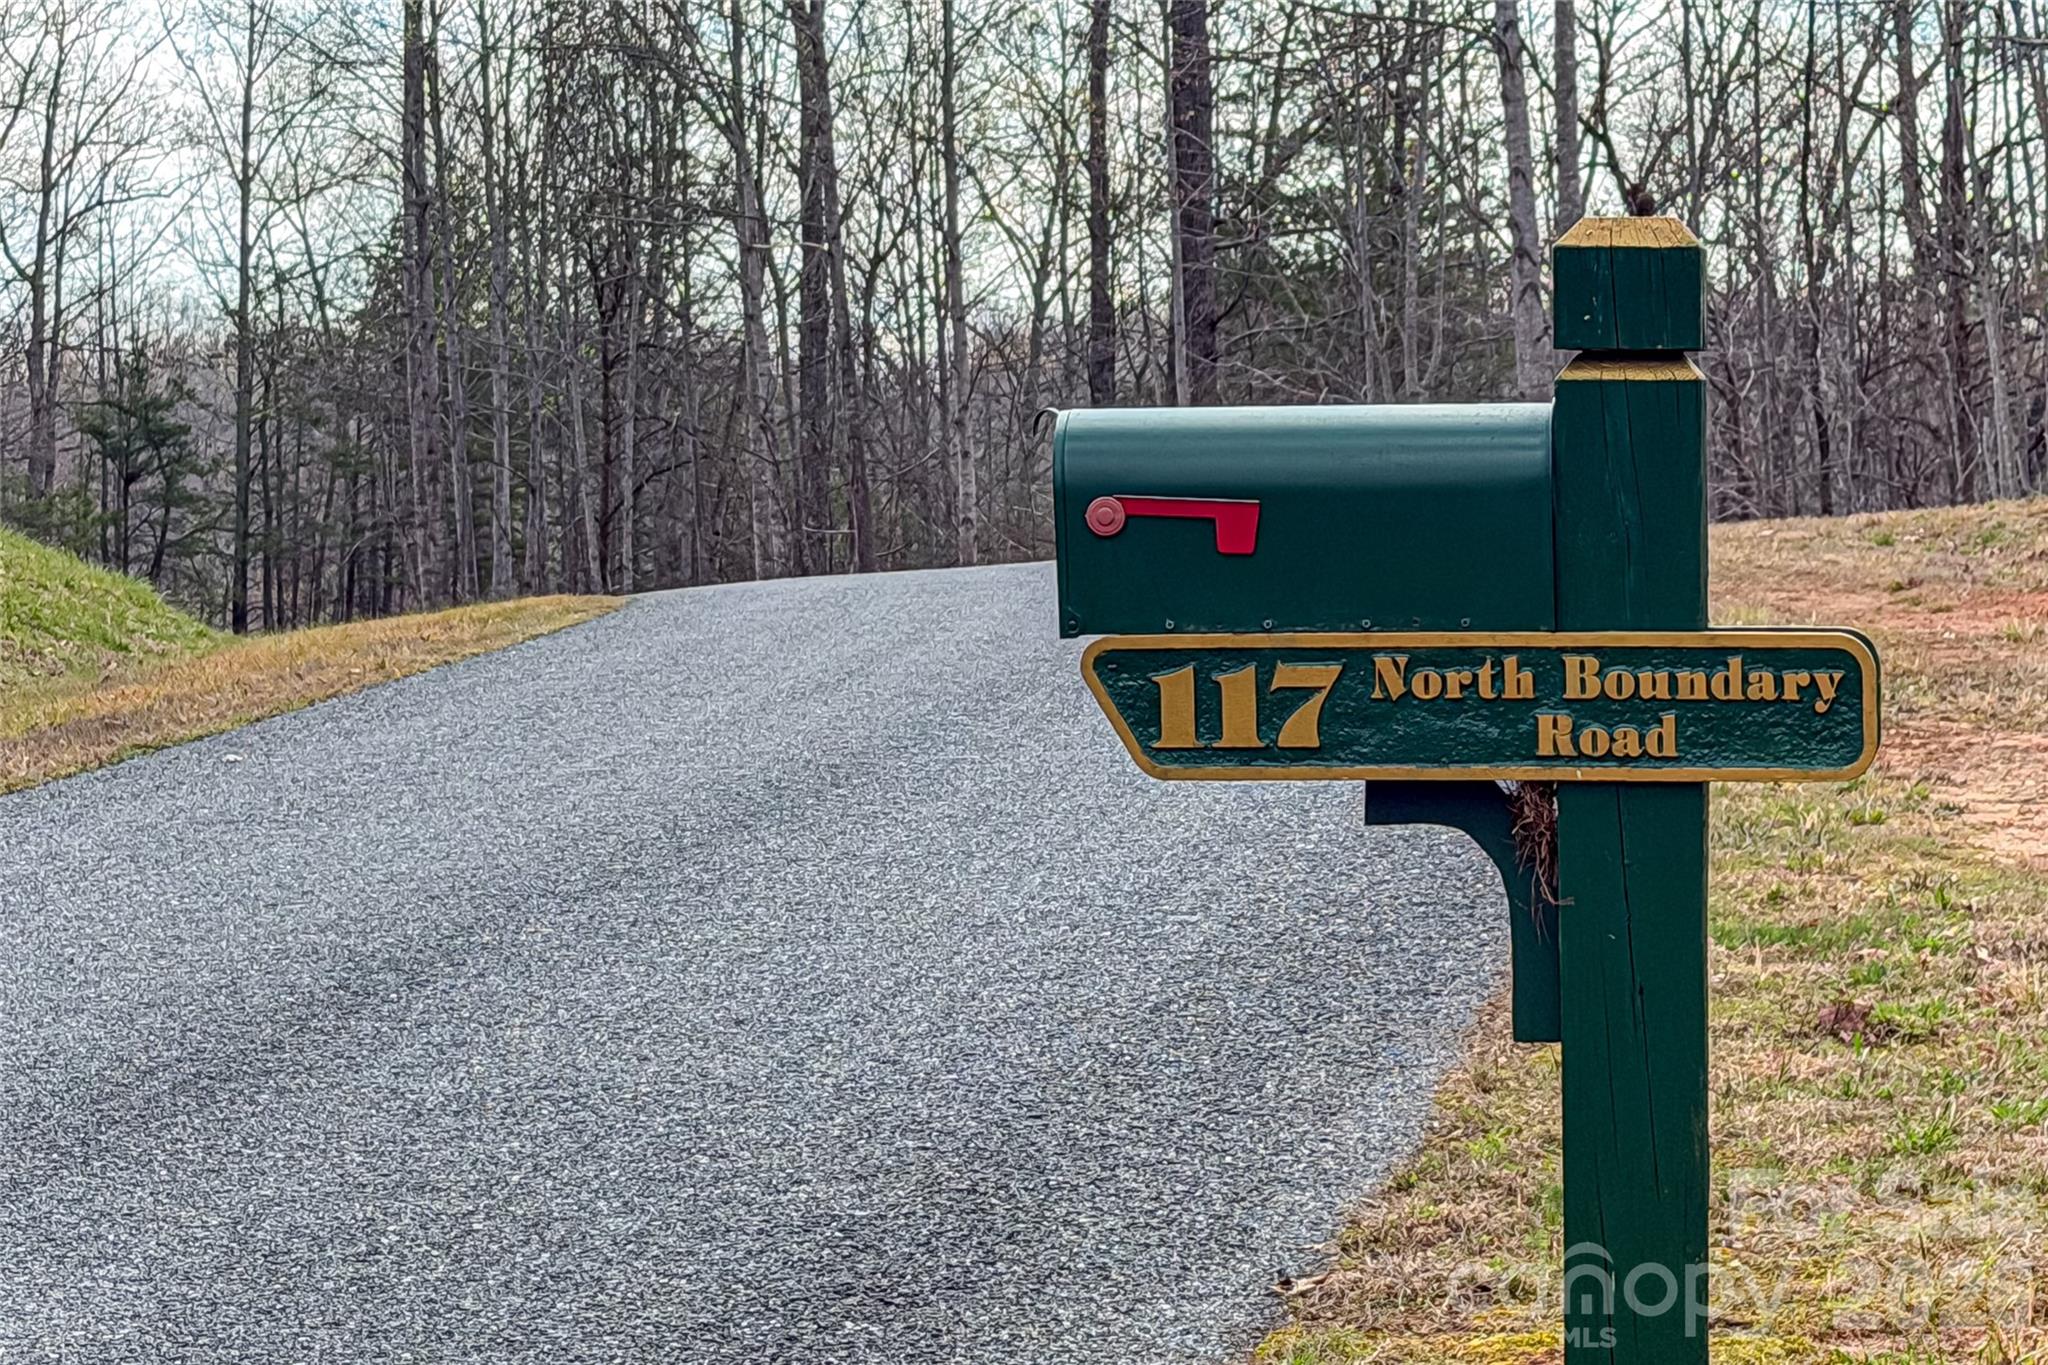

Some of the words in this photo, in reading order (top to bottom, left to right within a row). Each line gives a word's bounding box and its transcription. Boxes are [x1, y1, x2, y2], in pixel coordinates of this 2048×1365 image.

[1150, 663, 1343, 750] 117
[1371, 655, 1536, 701] North
[1562, 656, 1845, 714] Boundary
[1535, 714, 1678, 758] Road
